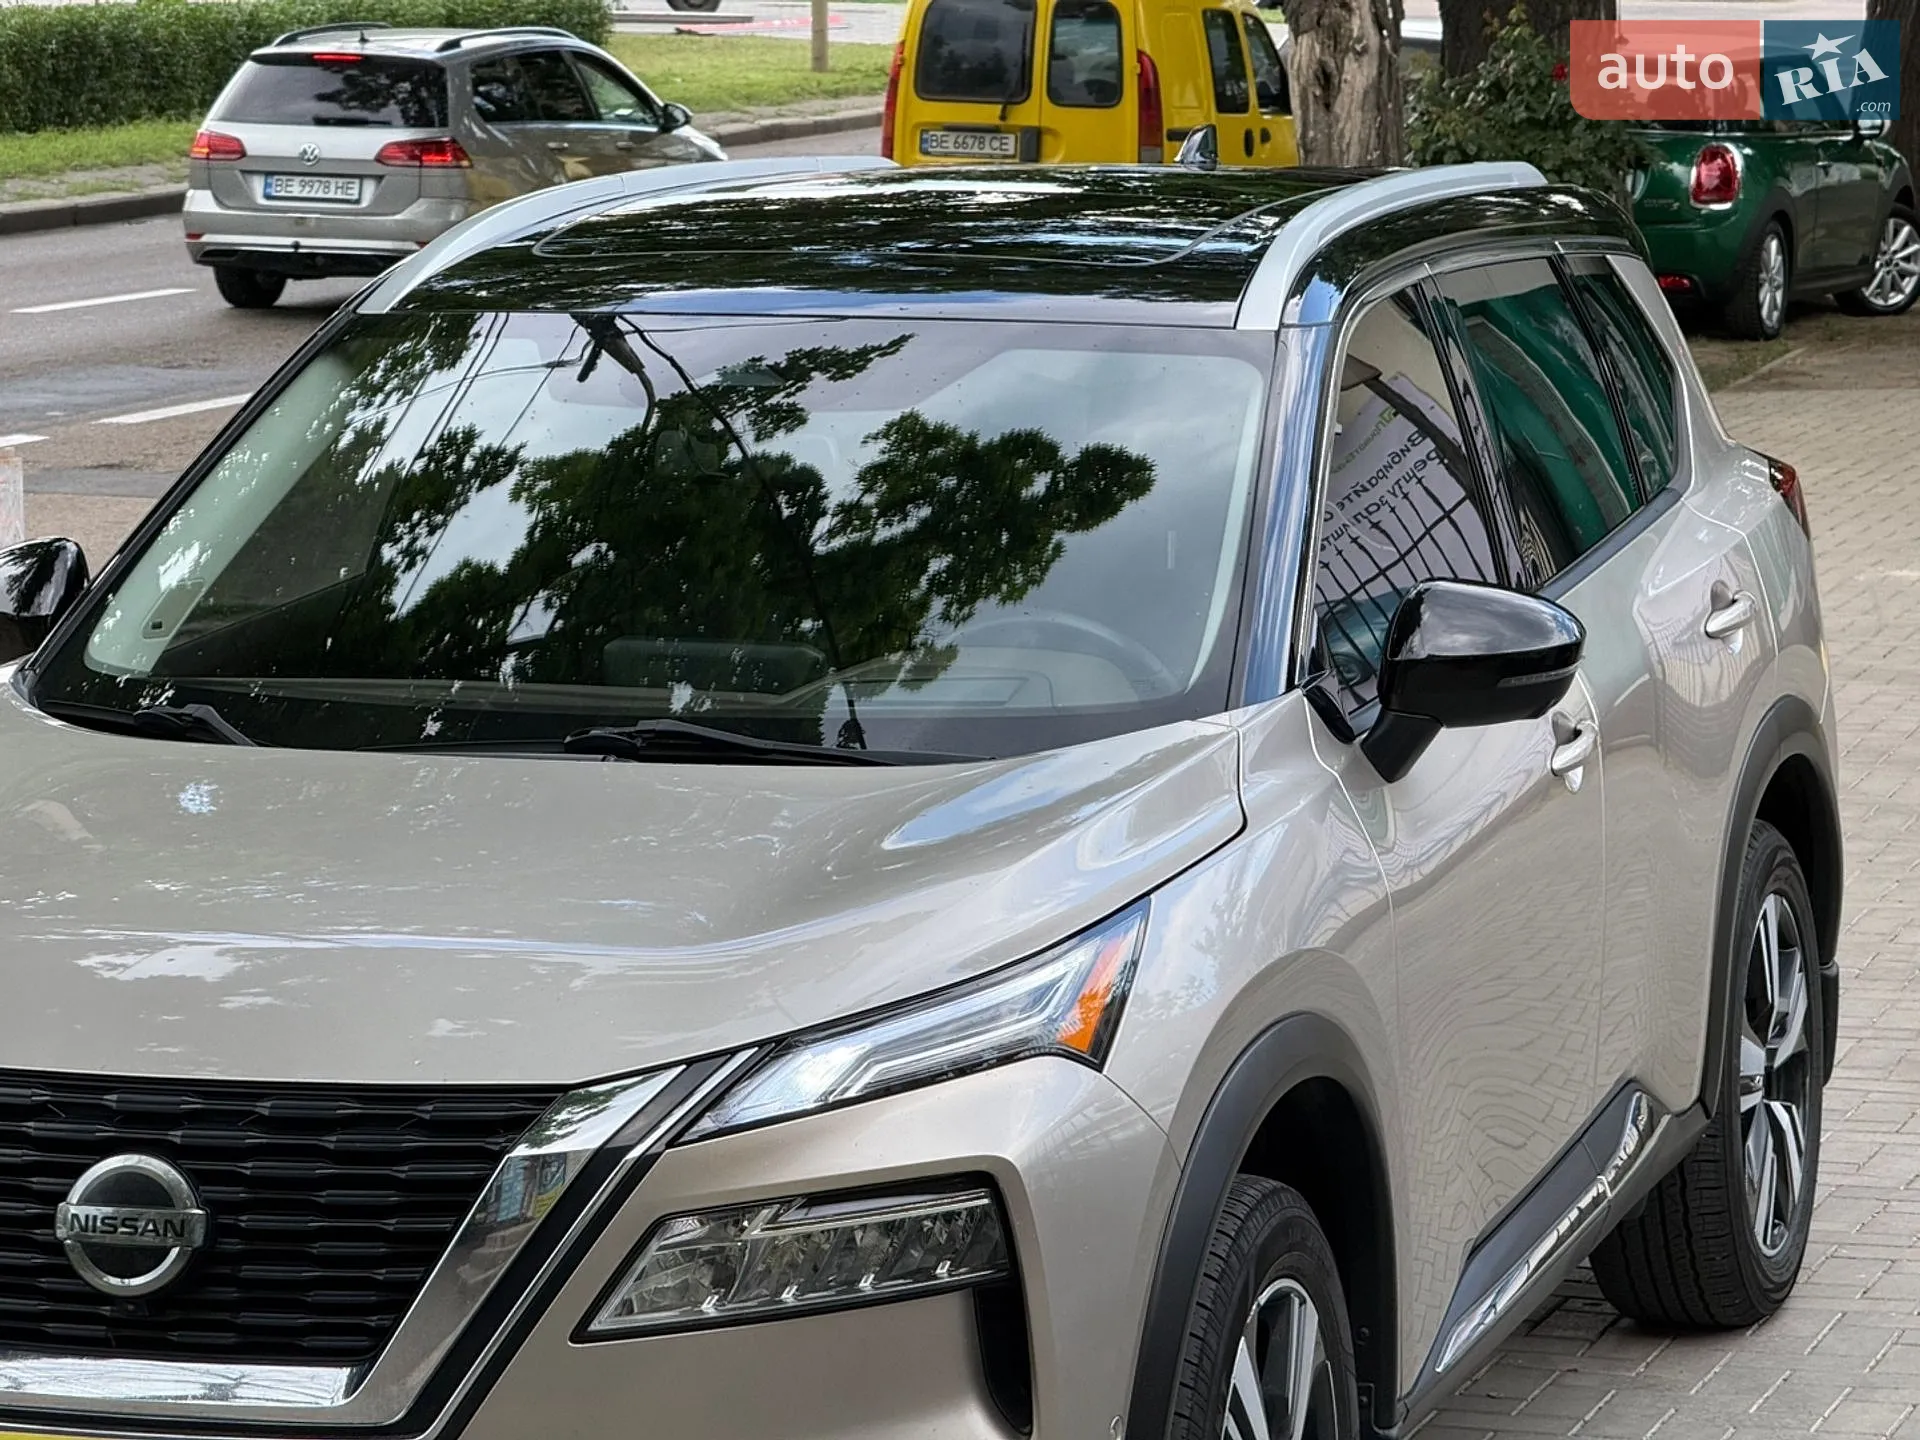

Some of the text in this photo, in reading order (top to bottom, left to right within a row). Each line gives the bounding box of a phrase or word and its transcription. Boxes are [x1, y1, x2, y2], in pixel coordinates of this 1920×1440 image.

[930, 134, 1010, 152] BE 6678 CE
[275, 178, 356, 196] BE 9978 HE
[69, 1213, 186, 1238] NISSAN
